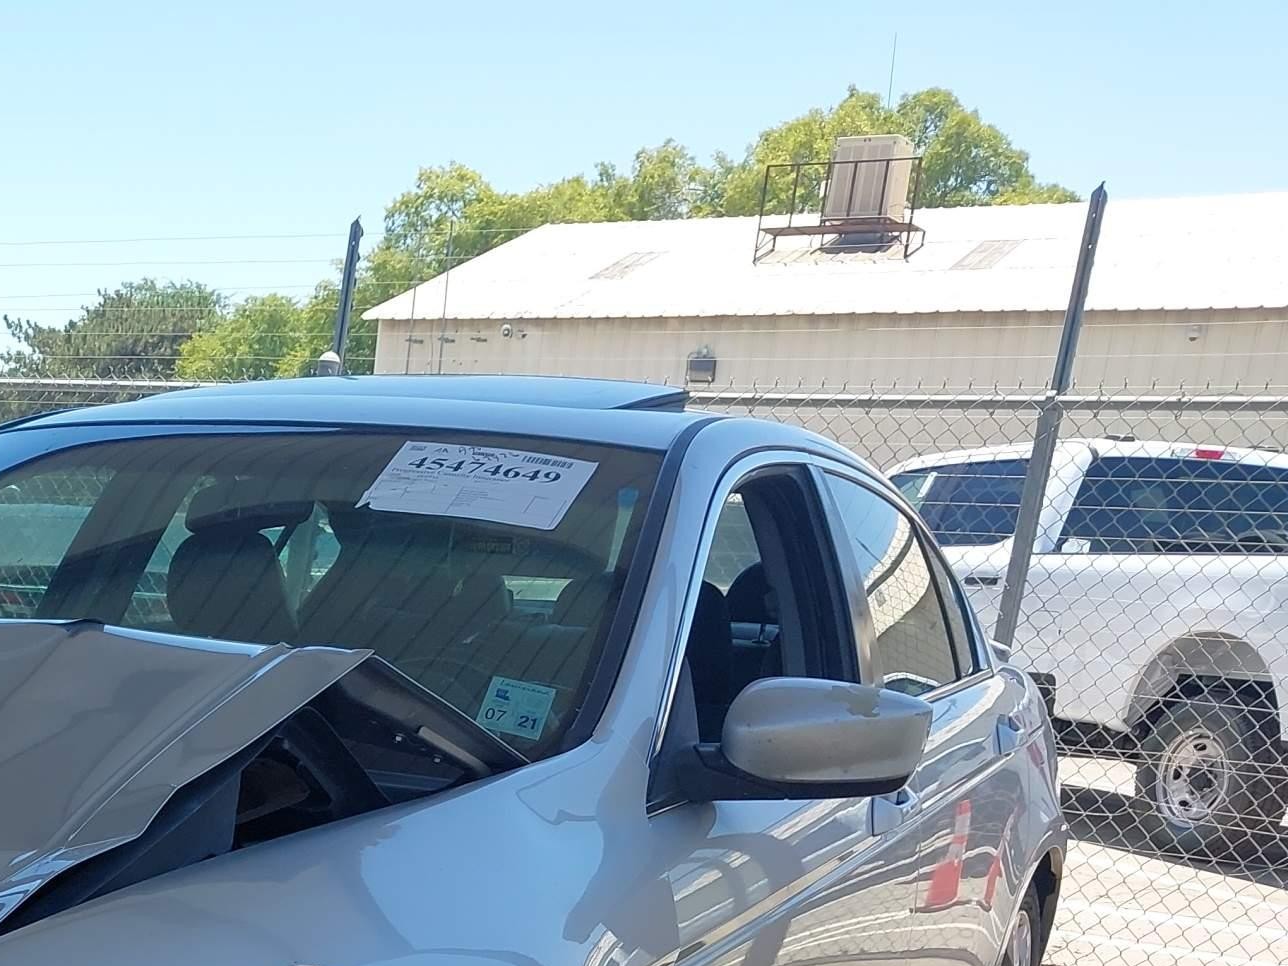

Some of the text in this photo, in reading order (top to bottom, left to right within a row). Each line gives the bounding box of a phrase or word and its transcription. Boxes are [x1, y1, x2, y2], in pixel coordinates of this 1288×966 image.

[408, 456, 562, 484] 45474649
[485, 707, 539, 730] 07 21
